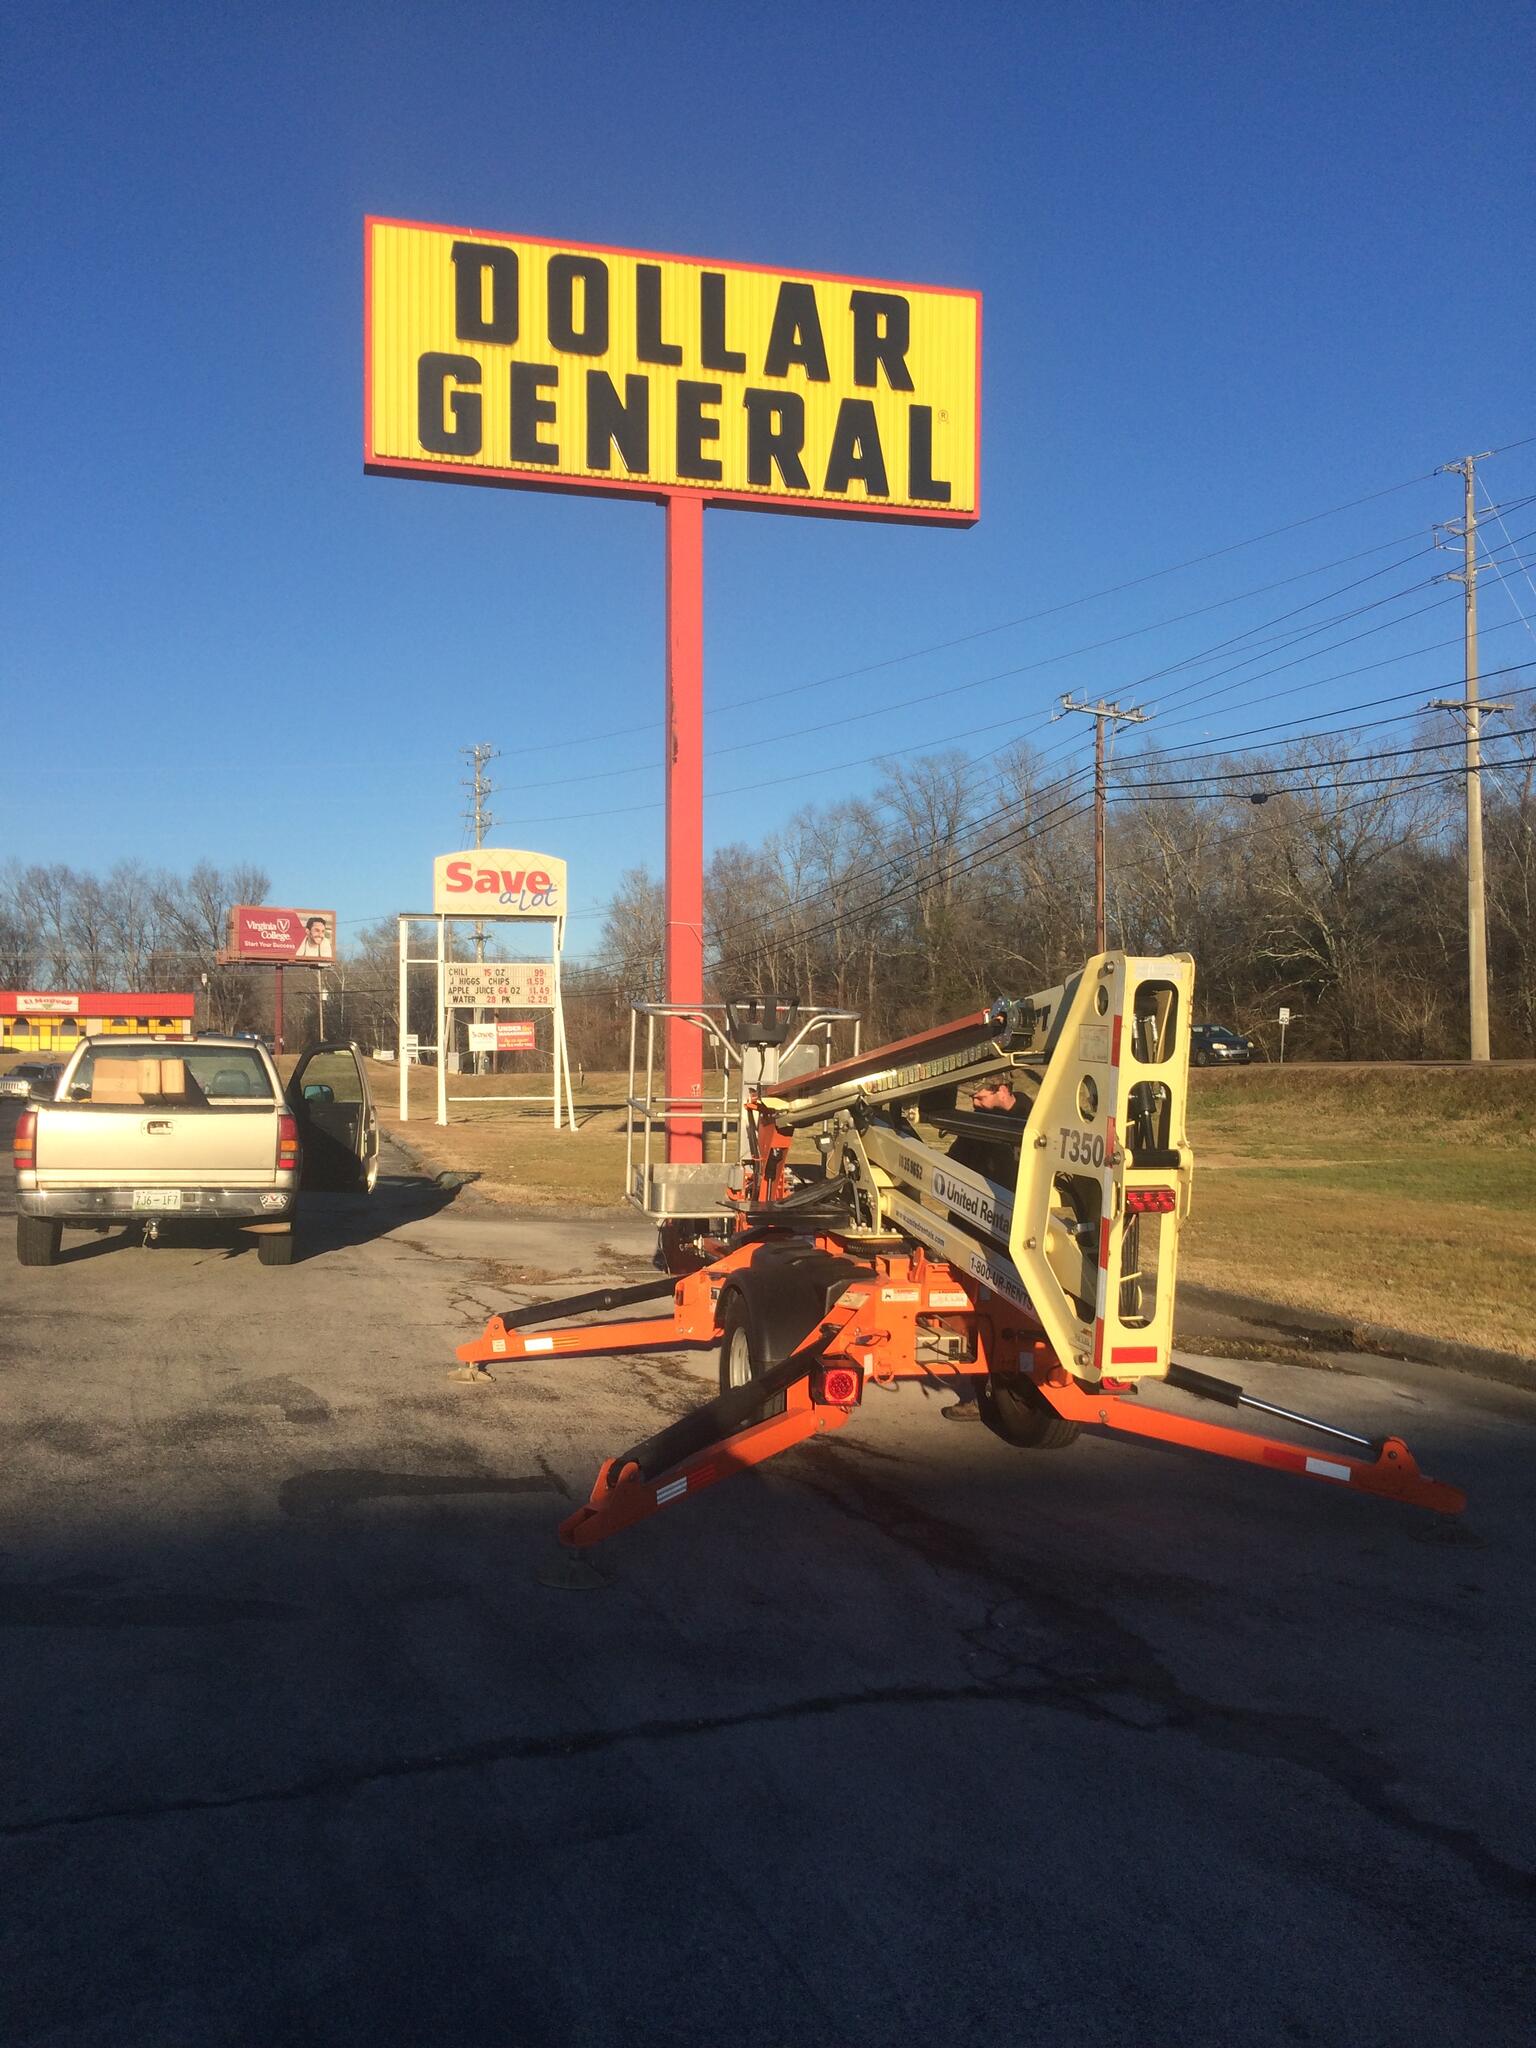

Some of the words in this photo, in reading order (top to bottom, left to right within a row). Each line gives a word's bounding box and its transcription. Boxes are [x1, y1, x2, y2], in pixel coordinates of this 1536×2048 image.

[451, 240, 915, 392] DOLLAR
[417, 351, 952, 502] GENERAL
[446, 861, 551, 895] Save
[499, 890, 518, 904] a
[246, 919, 277, 931] Virginia
[448, 968, 468, 976] CHILI
[1060, 1127, 1104, 1168] T350
[947, 1181, 979, 1216] United
[980, 1199, 1010, 1233] Renta
